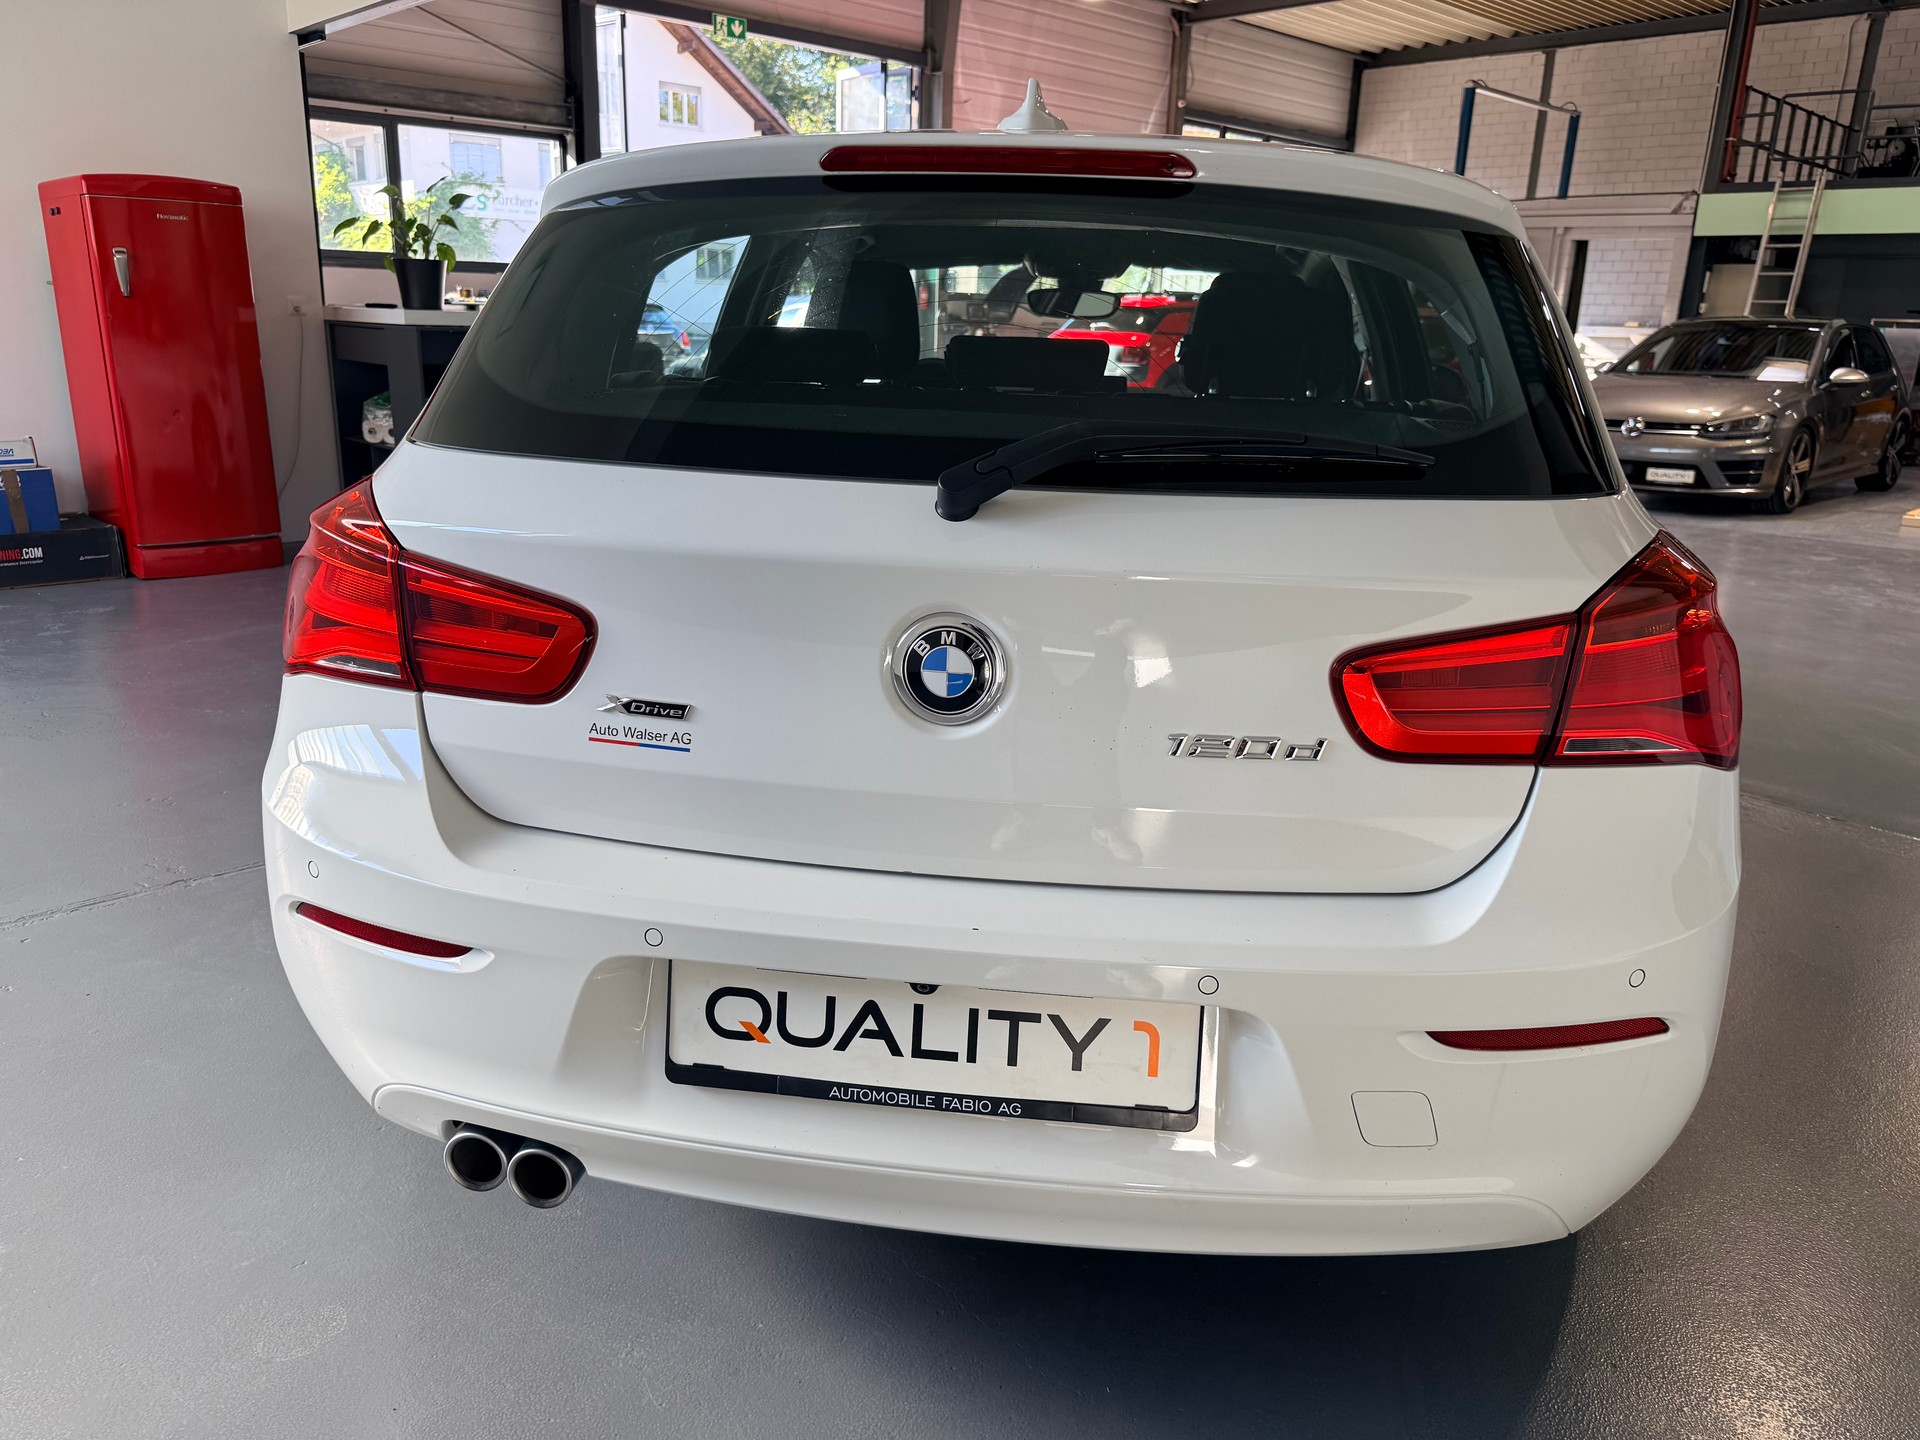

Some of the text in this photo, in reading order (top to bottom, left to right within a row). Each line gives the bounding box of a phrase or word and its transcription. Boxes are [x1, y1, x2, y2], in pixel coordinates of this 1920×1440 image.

[913, 631, 985, 661] BMW
[589, 722, 692, 745] Auto Walser AG
[1168, 733, 1328, 761] 120d
[705, 986, 1161, 1078] QUALITY 1
[828, 1086, 1022, 1116] AUTOMOBILE FABIO AG
